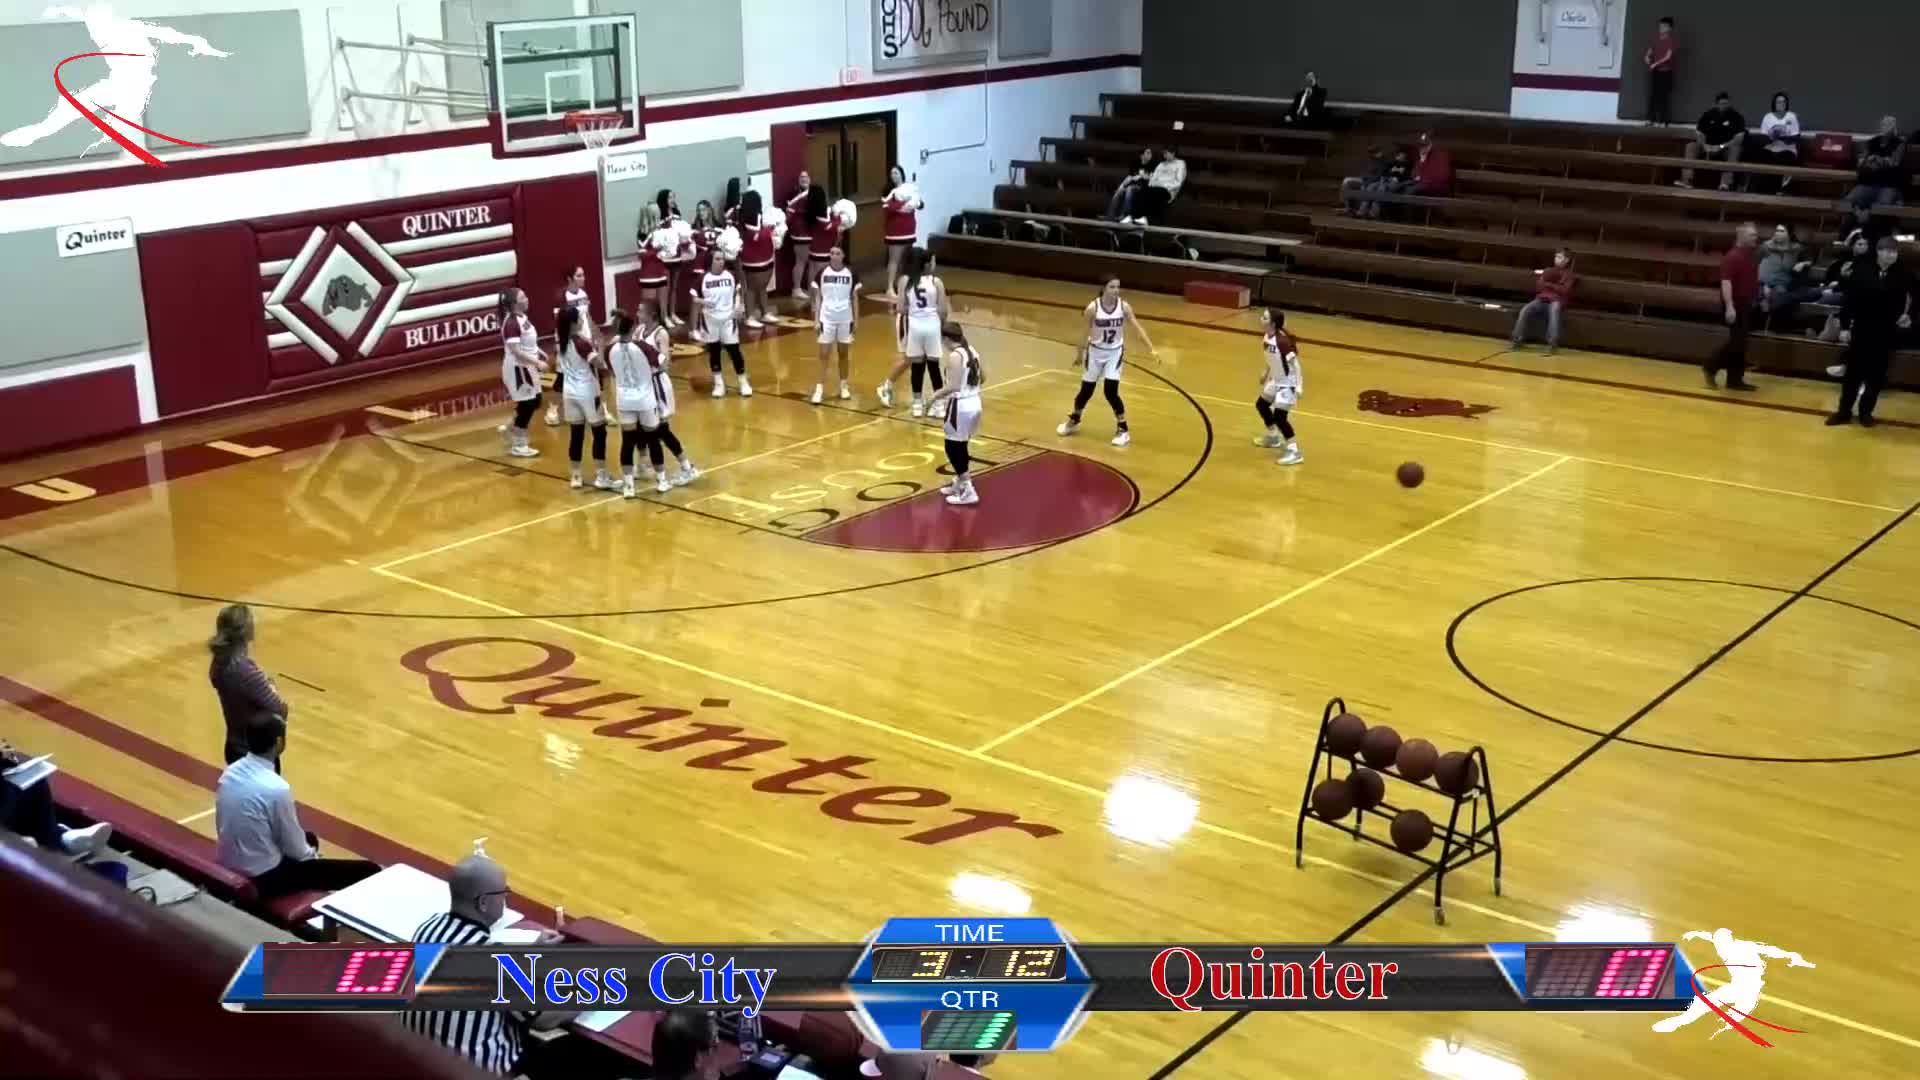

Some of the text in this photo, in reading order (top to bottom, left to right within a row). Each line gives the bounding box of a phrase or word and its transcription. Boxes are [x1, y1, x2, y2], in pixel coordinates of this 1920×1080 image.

[402, 205, 491, 237] QUINTER
[65, 229, 127, 250] Quinter
[914, 287, 928, 309] 5
[1103, 329, 1117, 344] 12
[400, 636, 1063, 846] Quinter
